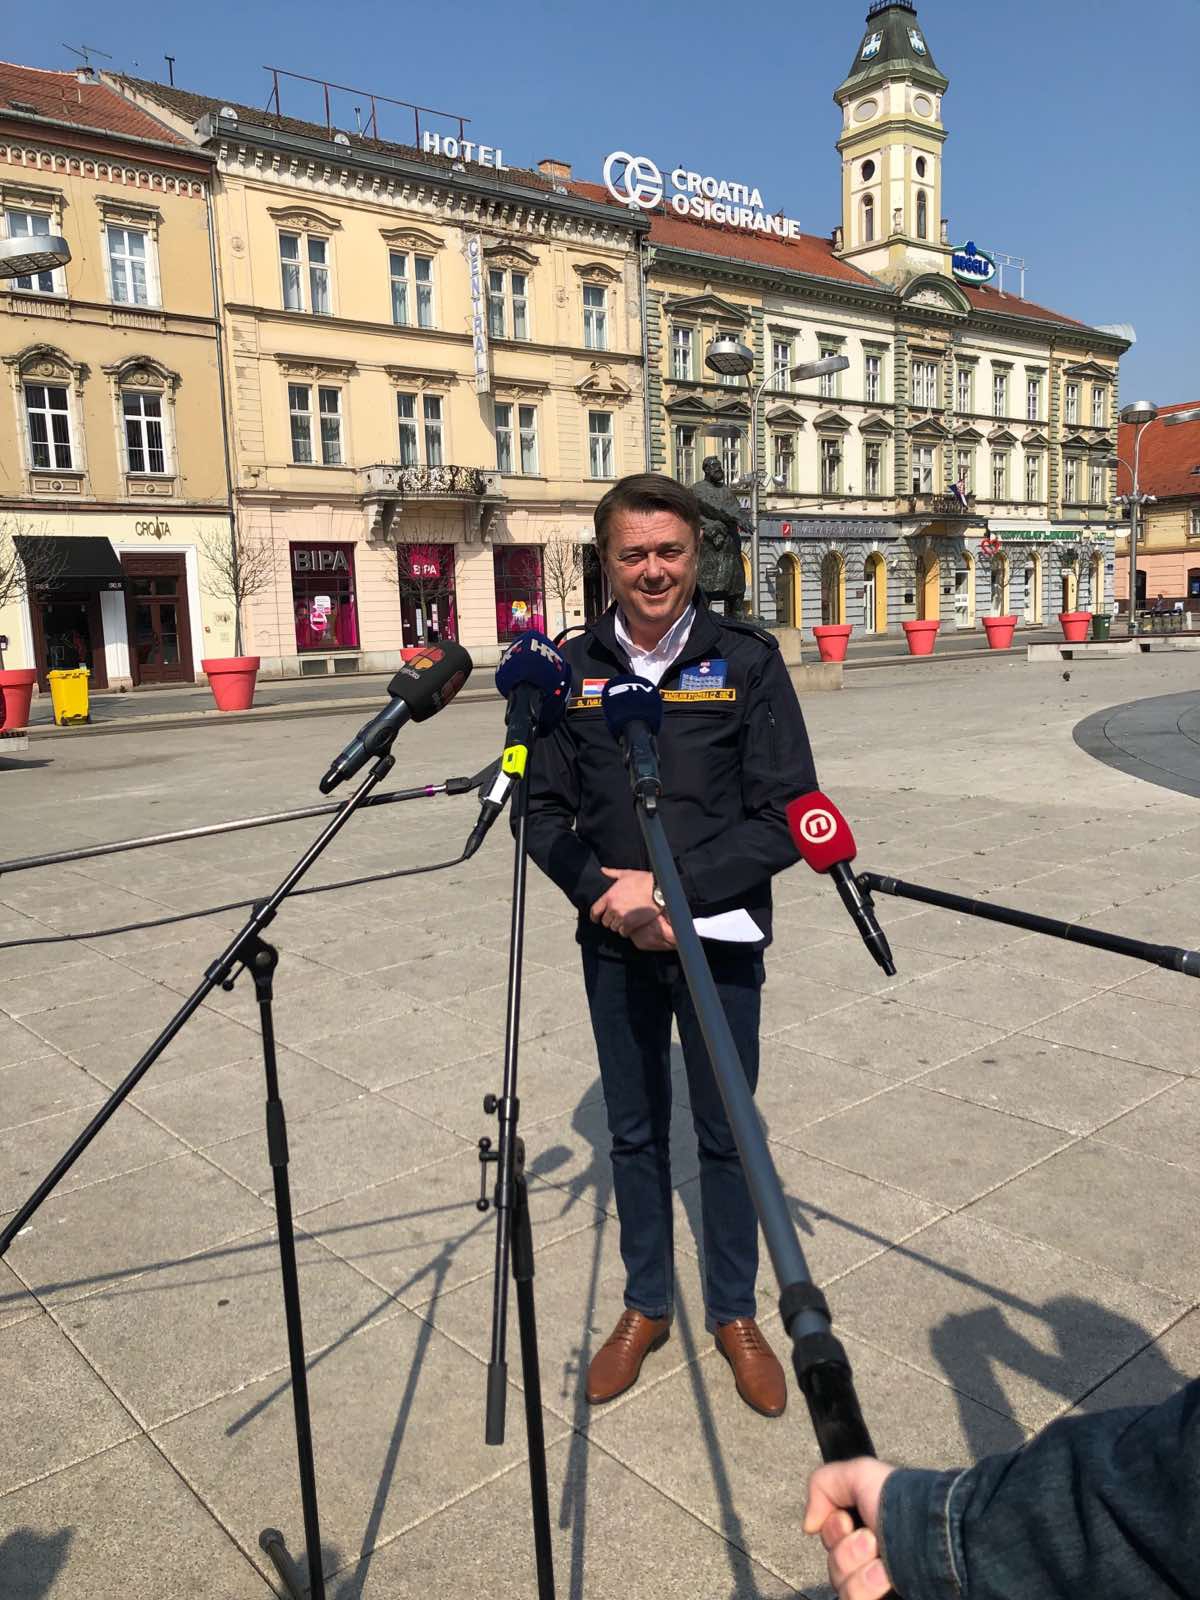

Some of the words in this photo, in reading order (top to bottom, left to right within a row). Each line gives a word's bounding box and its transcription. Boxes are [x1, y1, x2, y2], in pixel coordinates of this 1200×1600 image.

[423, 131, 509, 171] HOTEL
[671, 168, 764, 209] CROATIA
[671, 194, 800, 240] OSIGURANJE
[469, 239, 484, 374] CENTRAL
[293, 550, 349, 571] BIPA
[608, 683, 653, 696] STV
